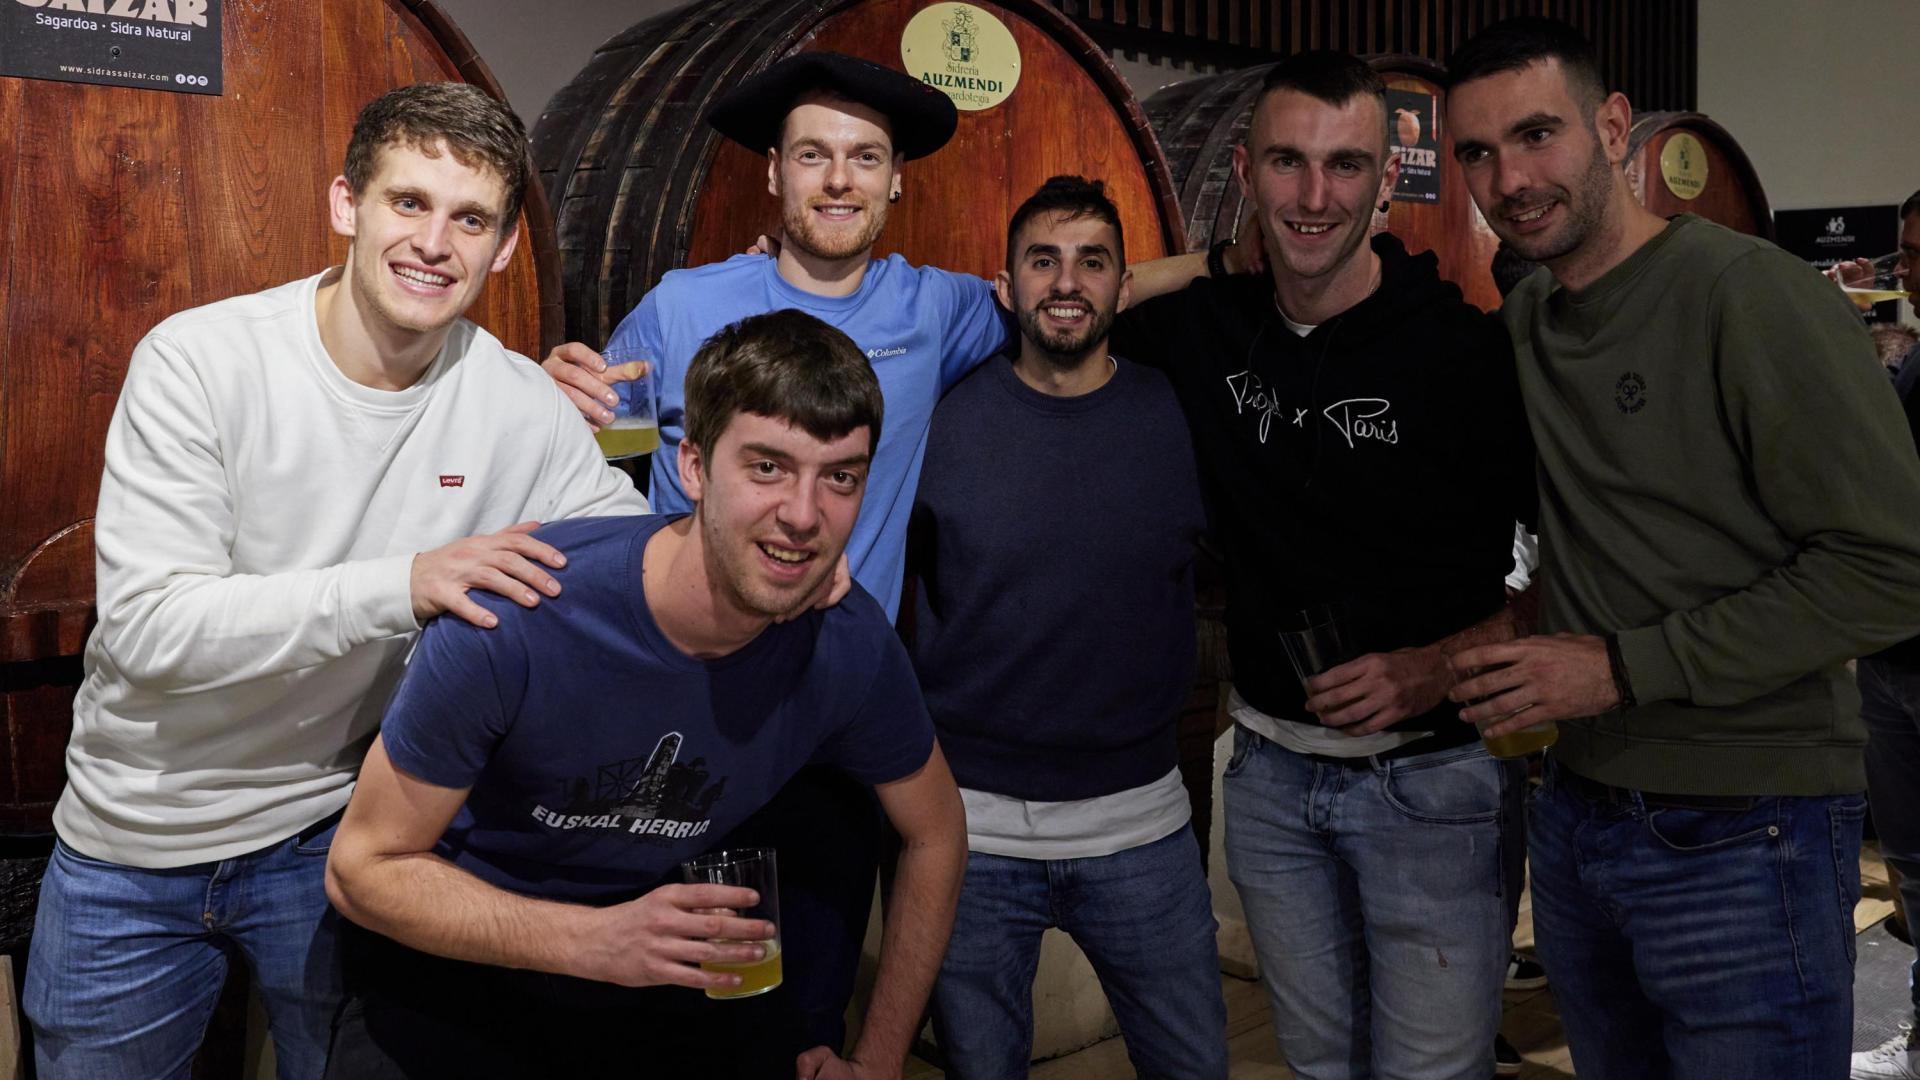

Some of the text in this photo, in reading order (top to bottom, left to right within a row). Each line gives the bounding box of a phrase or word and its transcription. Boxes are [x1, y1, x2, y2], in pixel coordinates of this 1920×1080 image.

[16, 0, 208, 28] ZAR
[35, 13, 192, 42] Sagardoa Sidra Natural
[59, 63, 170, 82] www.sidrassaizar.com
[922, 72, 1003, 93] AUZMENDI
[875, 346, 907, 358] Columbia
[1323, 398, 1398, 449] Paris
[531, 804, 711, 839] EUSKAL HERRIA
